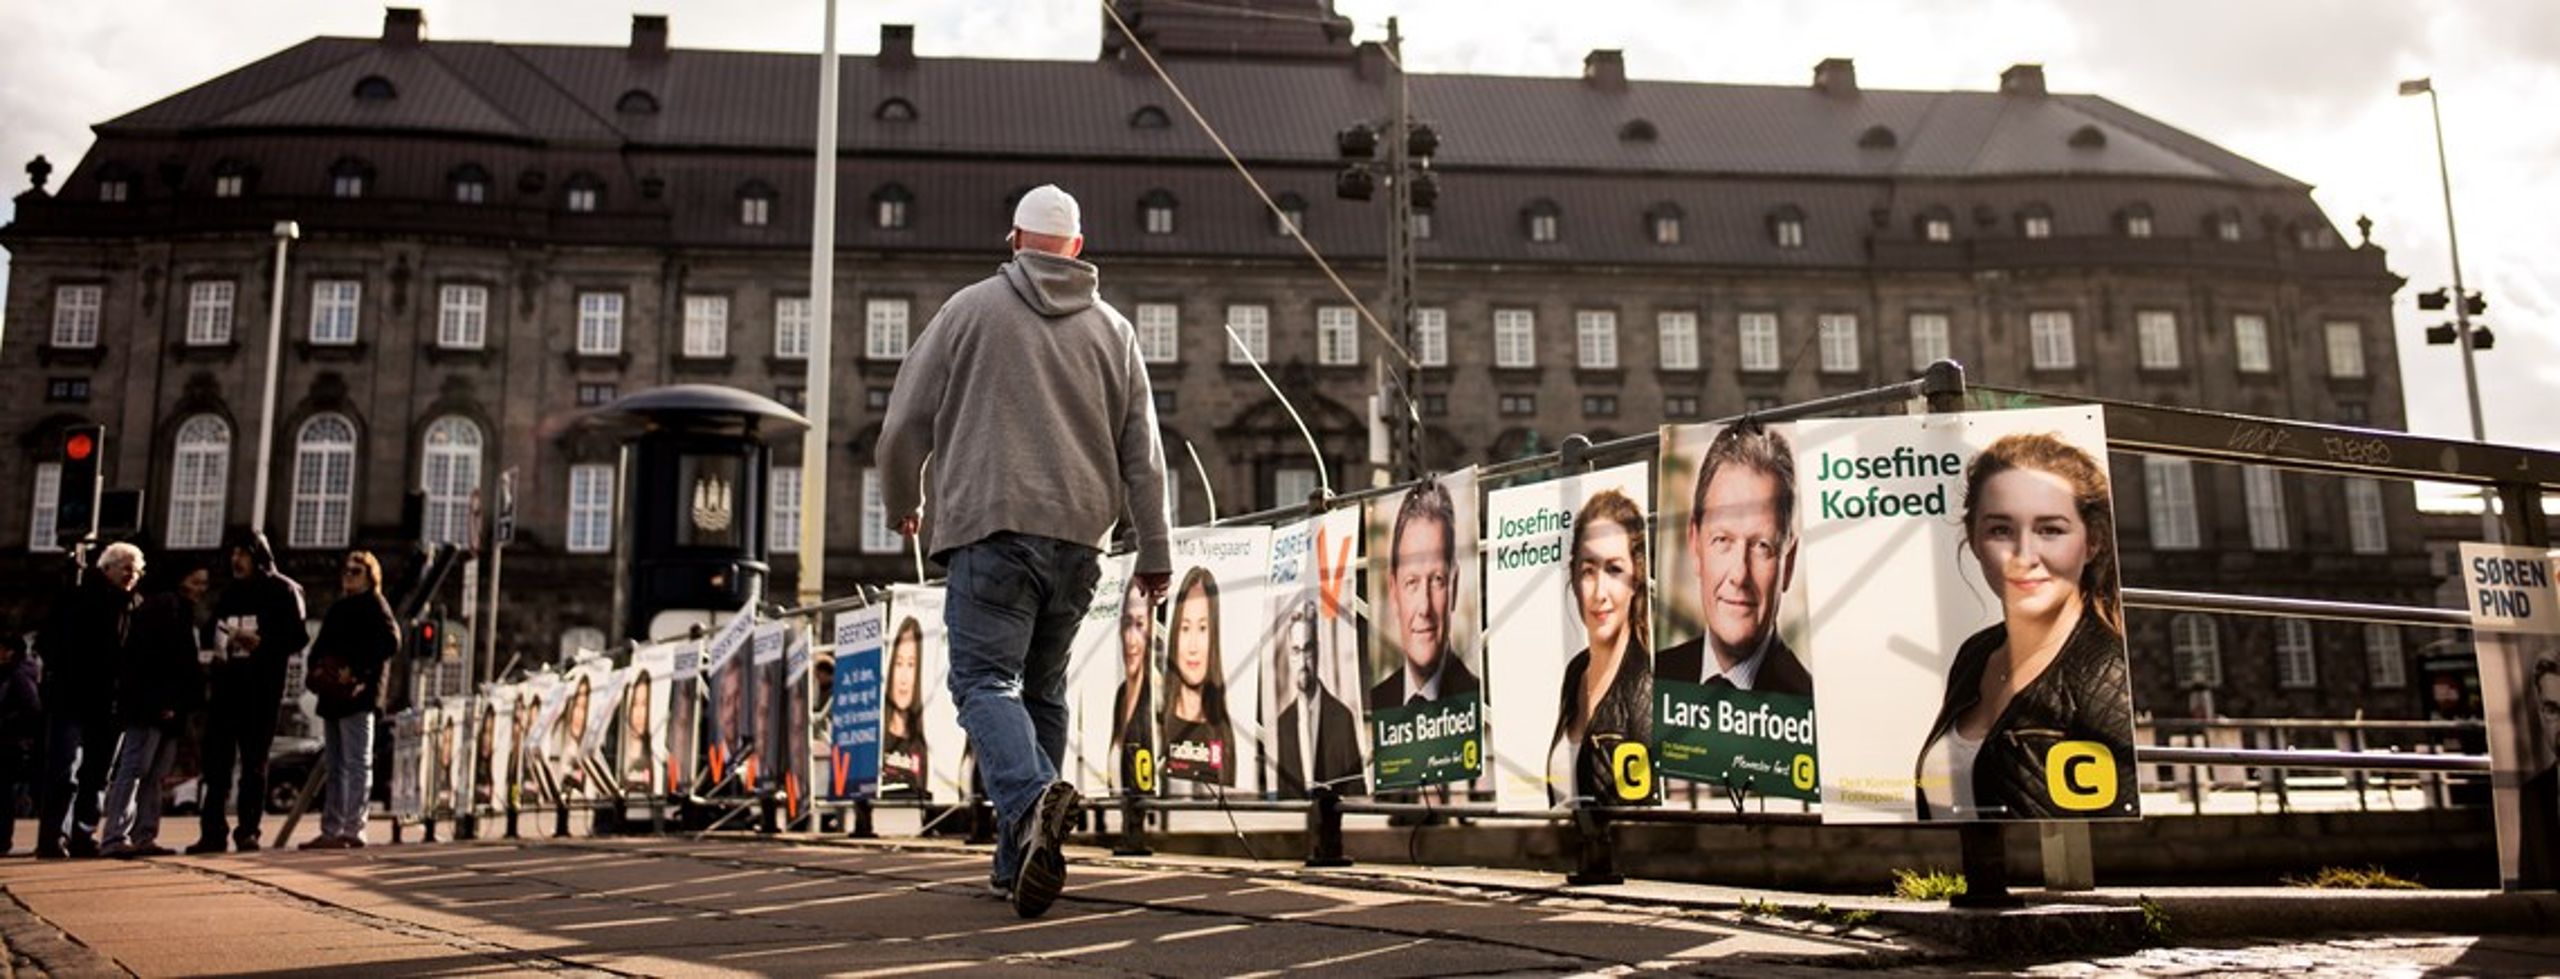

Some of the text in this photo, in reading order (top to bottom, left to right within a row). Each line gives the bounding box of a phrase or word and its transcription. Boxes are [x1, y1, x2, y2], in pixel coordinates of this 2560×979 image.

[1818, 446, 1961, 481] Josefine
[1821, 483, 1946, 519] Kofoed
[1497, 507, 1572, 540] Josefine
[1497, 536, 1562, 570] Kofoed
[1317, 524, 1352, 619] V
[2473, 556, 2547, 588] SØREN
[2478, 589, 2532, 619] PIND
[1379, 702, 1477, 746] Lars Barfoed
[1663, 692, 1814, 746] Lars Barfoed
[832, 744, 850, 797] V
[1622, 754, 1642, 787] C
[2063, 754, 2099, 796] C
